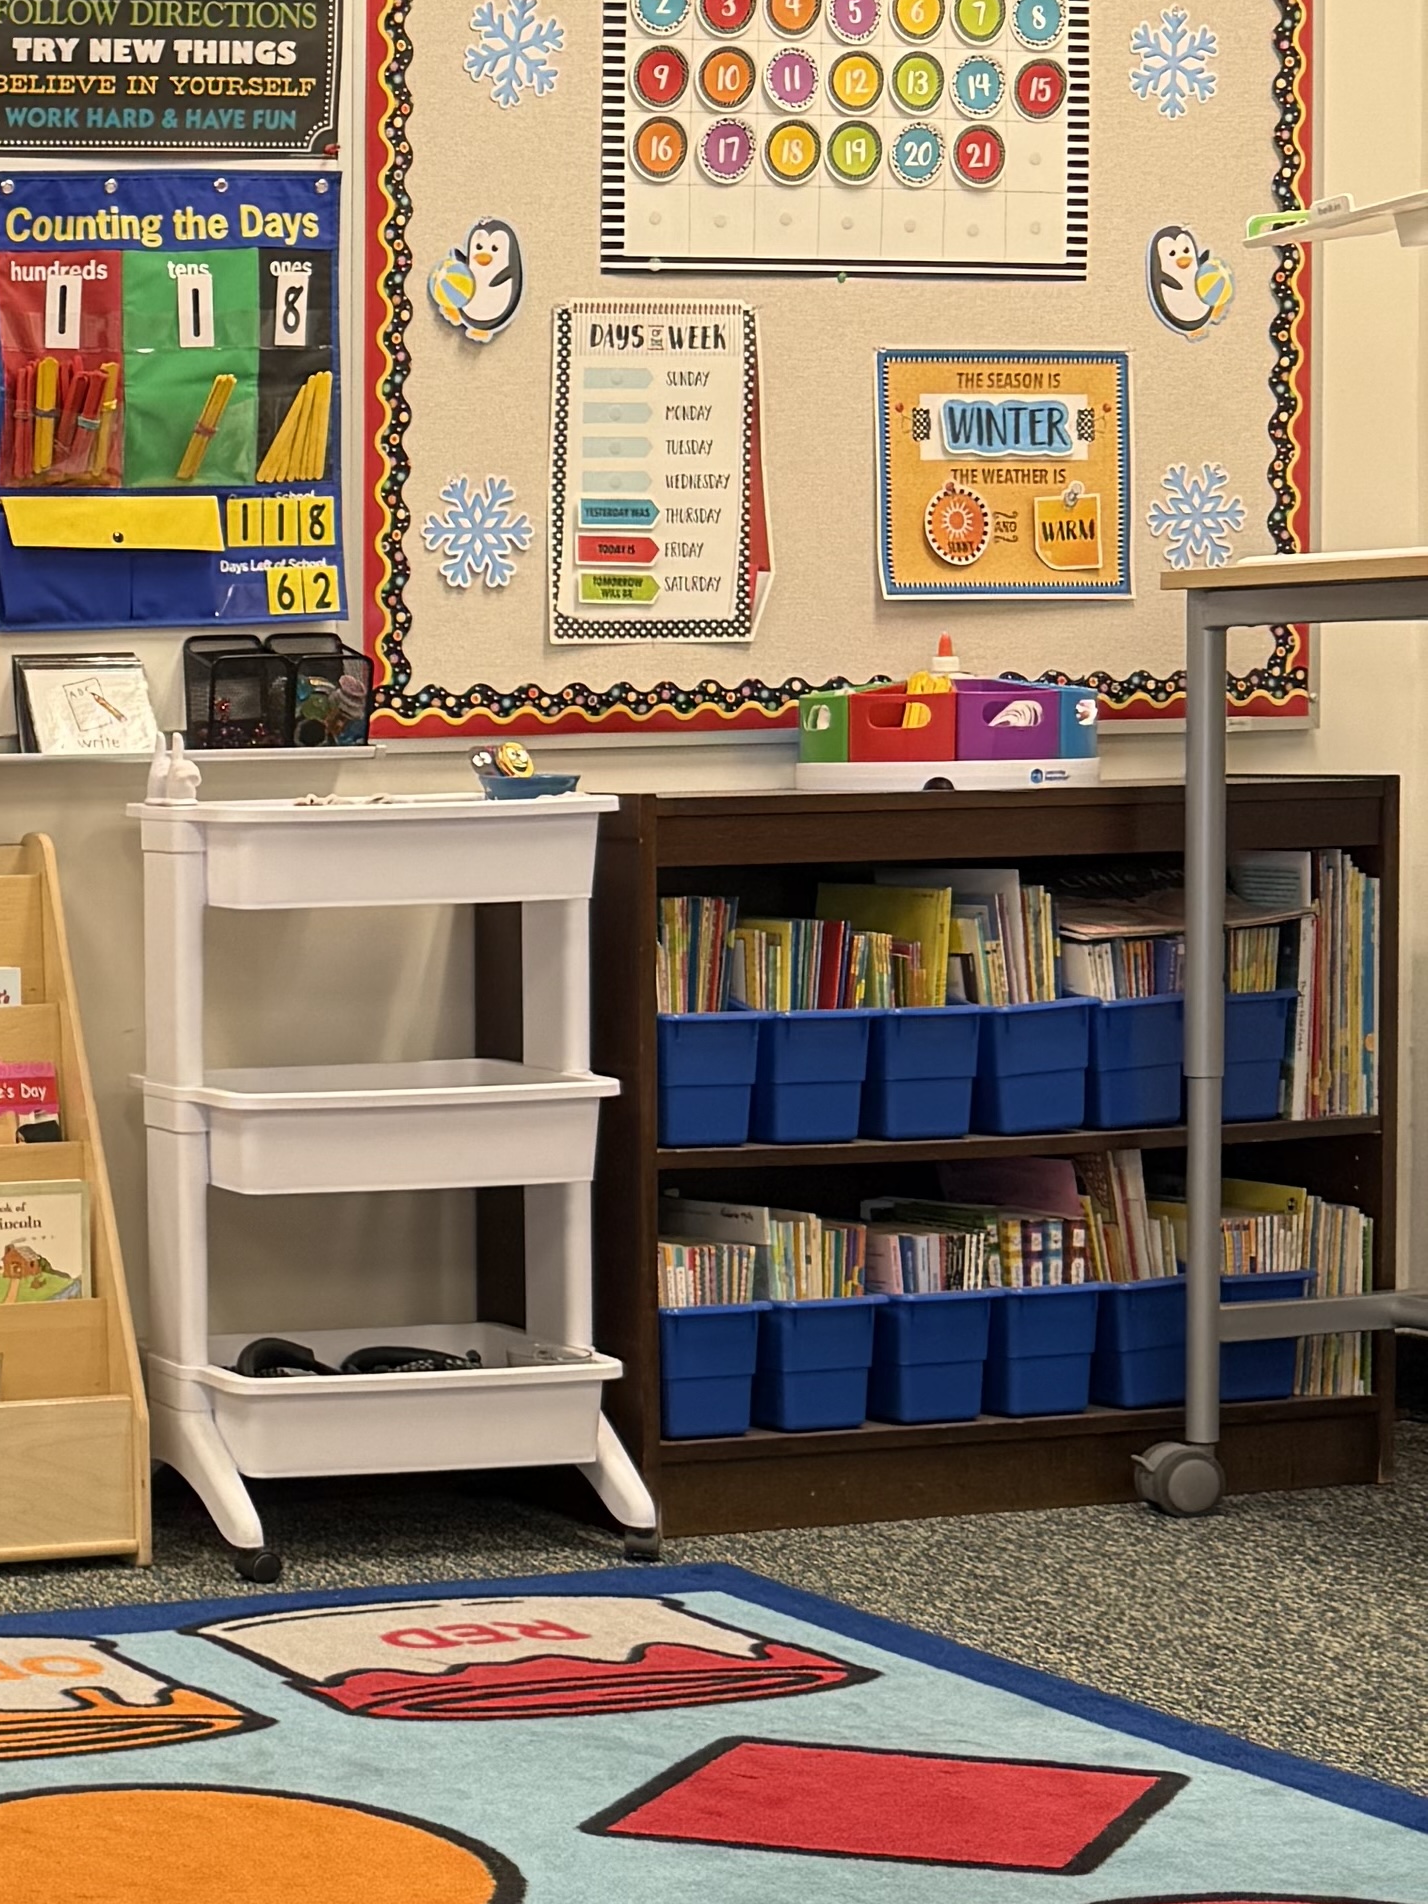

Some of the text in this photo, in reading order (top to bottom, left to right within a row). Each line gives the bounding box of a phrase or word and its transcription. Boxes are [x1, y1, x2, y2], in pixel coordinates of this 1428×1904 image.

[131, 0, 317, 30] DIRECTIONS
[12, 38, 296, 65] TRY NEW THINGS
[127, 76, 157, 94] IN
[170, 77, 316, 96] YOURSELF
[846, 70, 1052, 101] 12 14 15
[6, 108, 296, 131] WORK HARD & HAVE FUN
[719, 137, 991, 168] 17 19 20 21
[6, 206, 319, 247] Counting the Days
[11, 260, 312, 281] hundreds tens ones
[591, 324, 726, 350] DAYS WEEK
[957, 372, 1060, 388] THE SEASON IS
[948, 407, 1069, 446] WINTER
[951, 469, 1065, 484] THE WEATHER IS
[665, 508, 721, 523] THURSDAY
[1042, 519, 1094, 542] WARM
[665, 542, 703, 557] FRIDAY
[664, 576, 721, 592] SATURDAY
[21, 1084, 46, 1101] Day
[382, 1620, 591, 1649] RED
